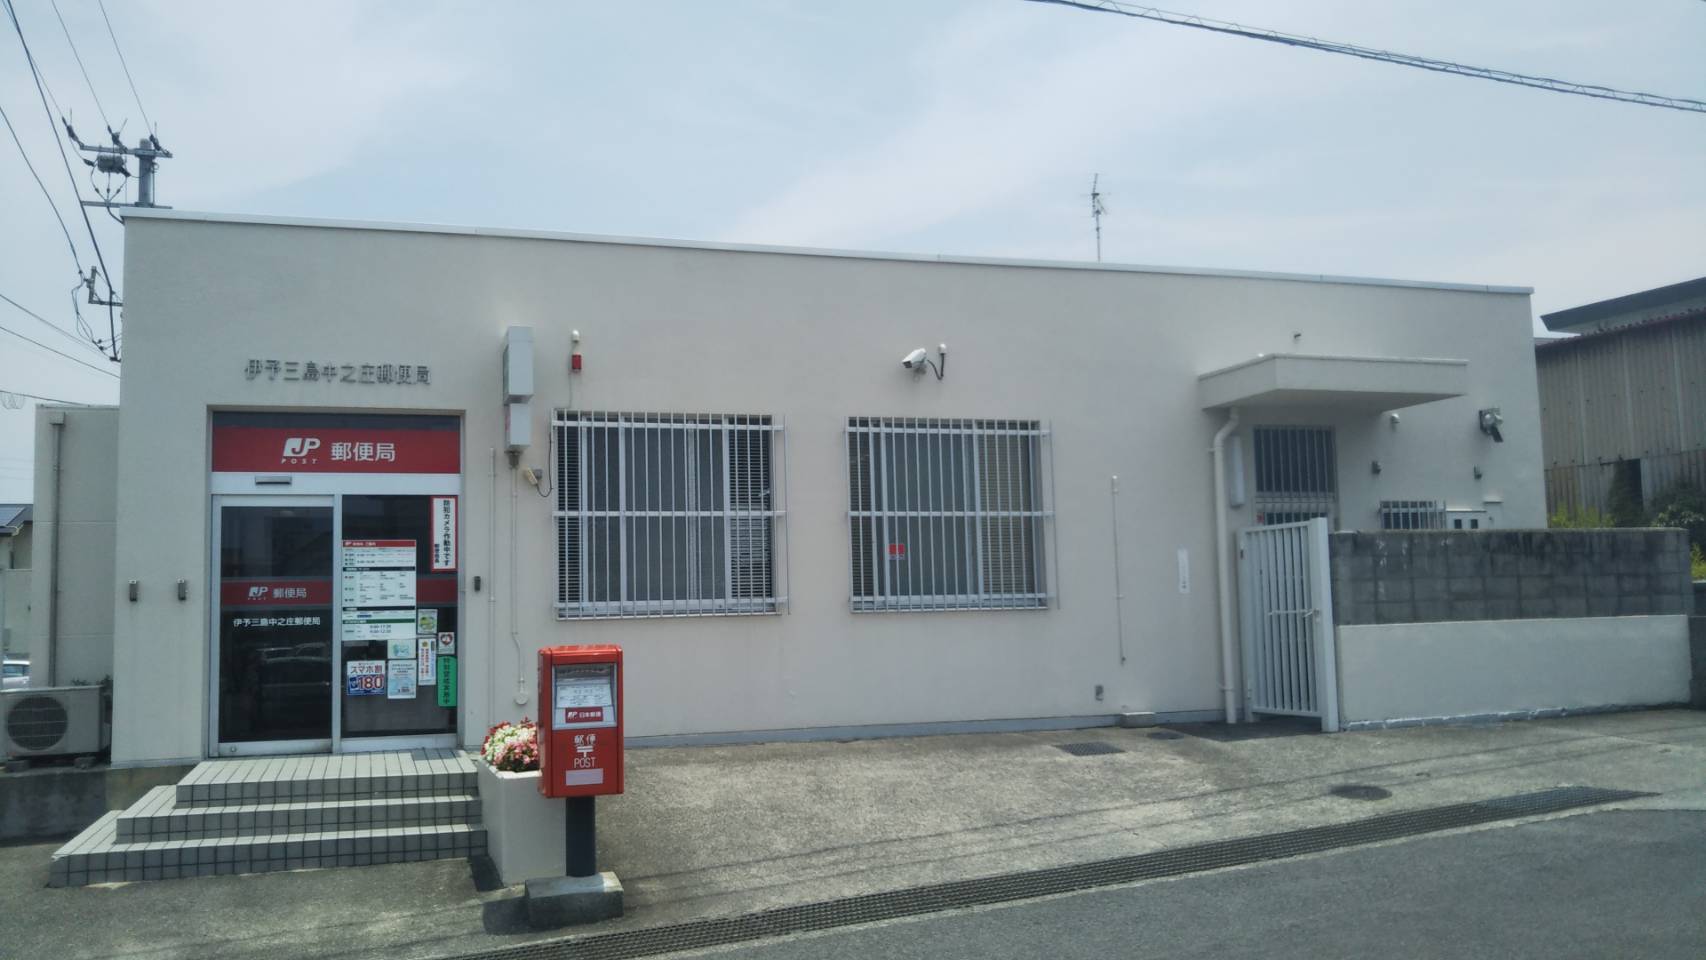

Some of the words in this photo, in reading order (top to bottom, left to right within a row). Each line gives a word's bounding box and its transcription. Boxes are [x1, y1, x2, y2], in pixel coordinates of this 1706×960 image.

[244, 359, 431, 386] 伊予三島中之庄郵便局
[331, 442, 396, 462] 郵便局
[272, 587, 307, 599] 郵便局
[233, 616, 321, 627] 伊予三島中之庄郵便局
[358, 676, 383, 689] 180
[574, 734, 596, 746] 郵便
[574, 757, 596, 768] POST
